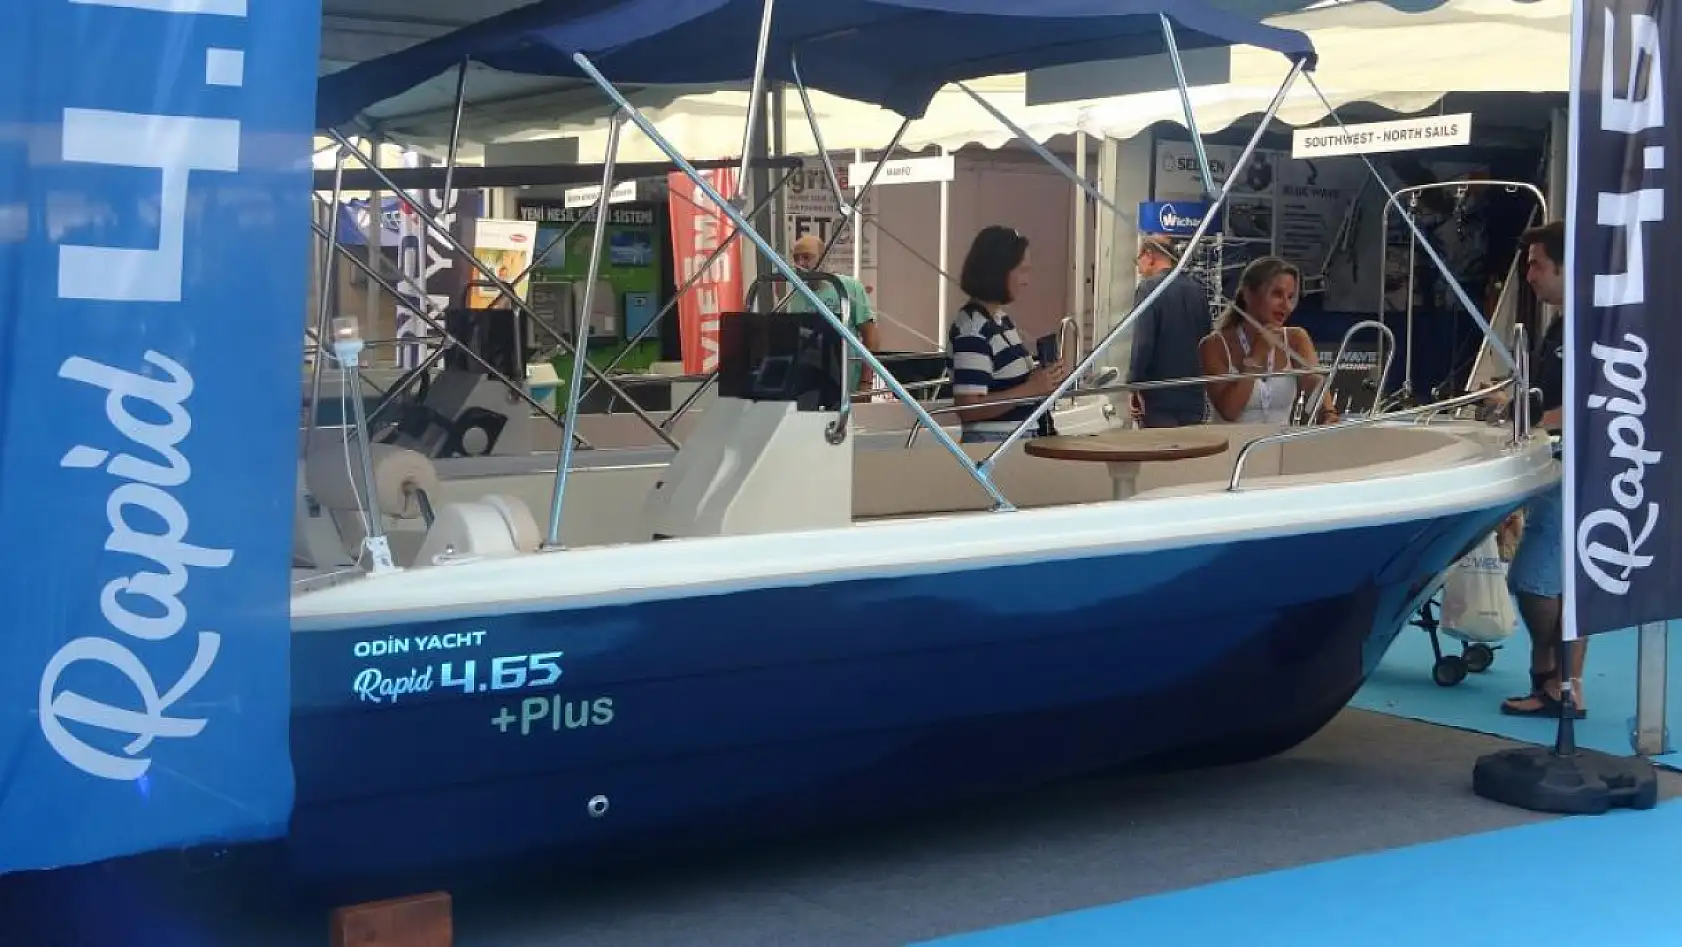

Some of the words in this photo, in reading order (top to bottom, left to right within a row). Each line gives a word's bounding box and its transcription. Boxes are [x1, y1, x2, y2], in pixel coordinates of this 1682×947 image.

[57, 0, 248, 302] 4.
[1304, 132, 1374, 149] SOUTHWEST
[1383, 128, 1422, 142] NORTH
[1425, 123, 1458, 139] SAILS
[1177, 158, 1226, 174] SELEN
[1577, 332, 1662, 597] Rapid
[38, 347, 235, 782] Rapid
[414, 630, 488, 651] YACHT
[353, 664, 434, 704] Rapid
[440, 650, 564, 694] 4.65
[491, 693, 614, 736] +Plus
